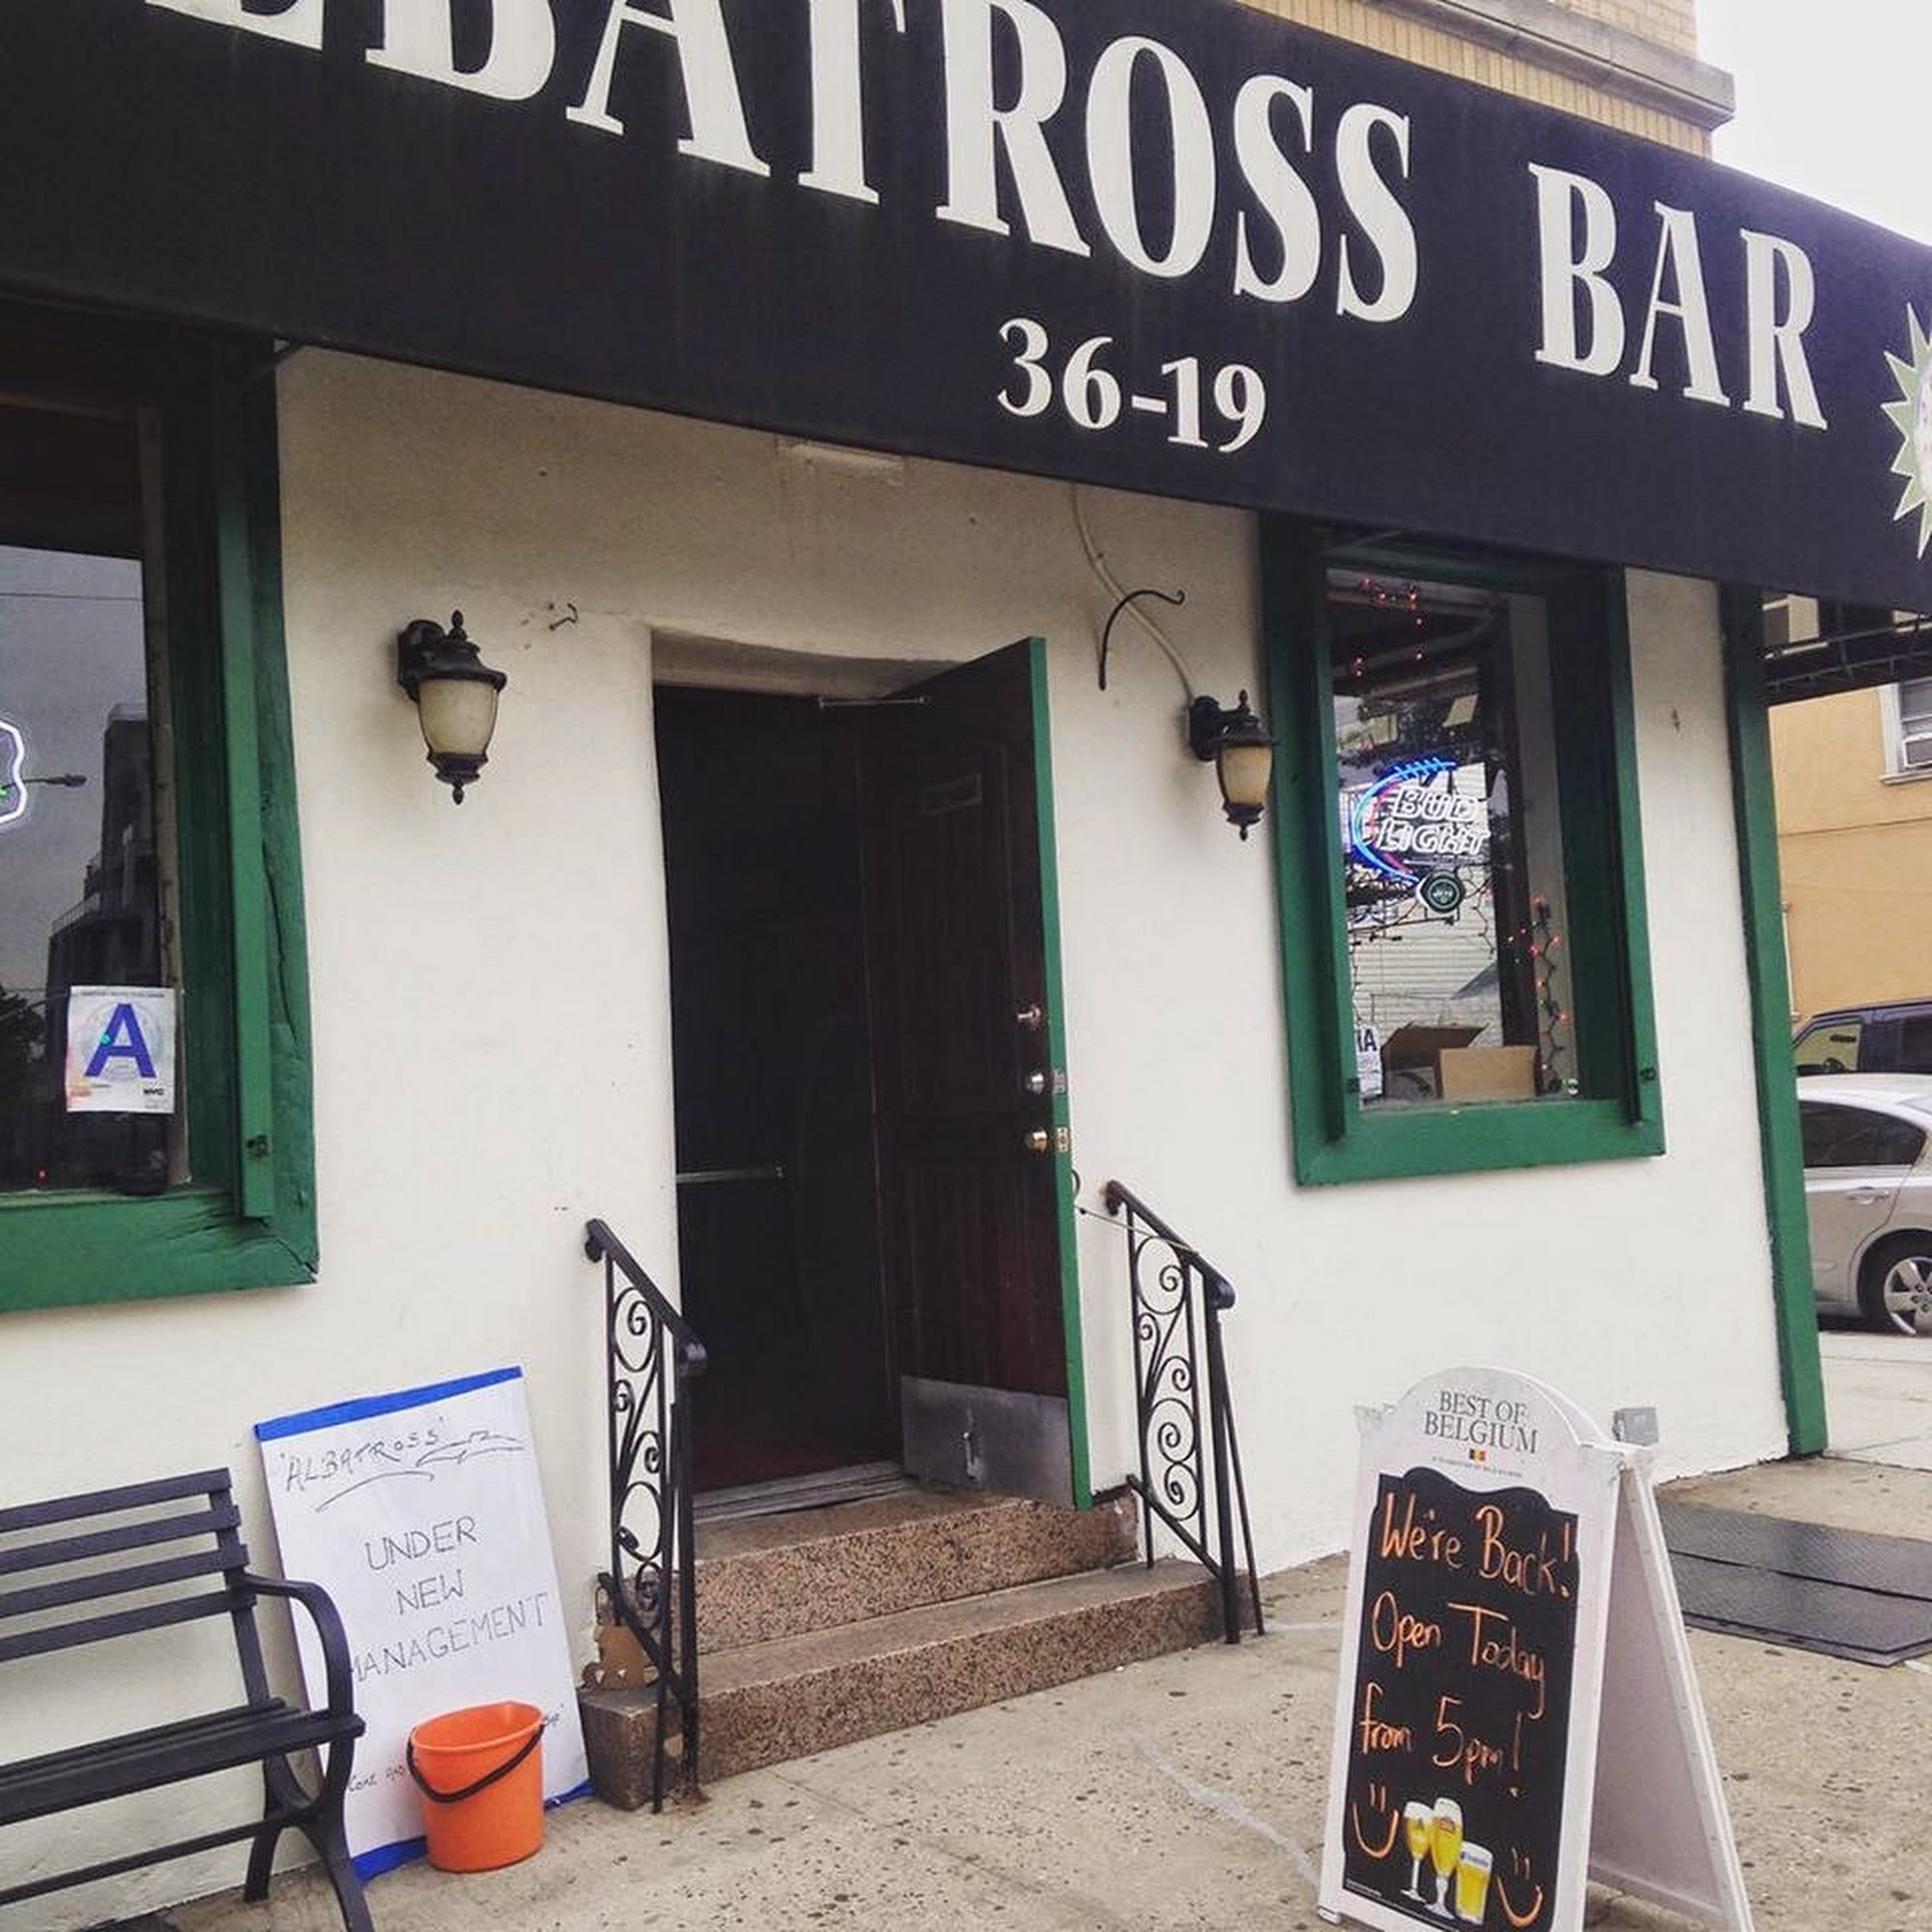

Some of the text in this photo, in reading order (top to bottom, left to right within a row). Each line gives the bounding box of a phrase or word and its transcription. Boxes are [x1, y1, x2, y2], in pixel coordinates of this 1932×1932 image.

[143, 0, 1827, 430] ATROSS BAR
[996, 317, 1267, 454] 36-19
[1391, 785, 1479, 822] BUD
[1376, 816, 1492, 856] LIGHT
[84, 1003, 156, 1078] A
[1424, 1410, 1539, 1454] BELGIUM
[1438, 1390, 1528, 1426] BEST OF
[364, 1516, 478, 1571] UNDER
[1475, 1504, 1572, 1599] Back!
[396, 1569, 465, 1615] NEW
[1371, 1591, 1546, 1719] Open Today
[1359, 1682, 1412, 1755] from
